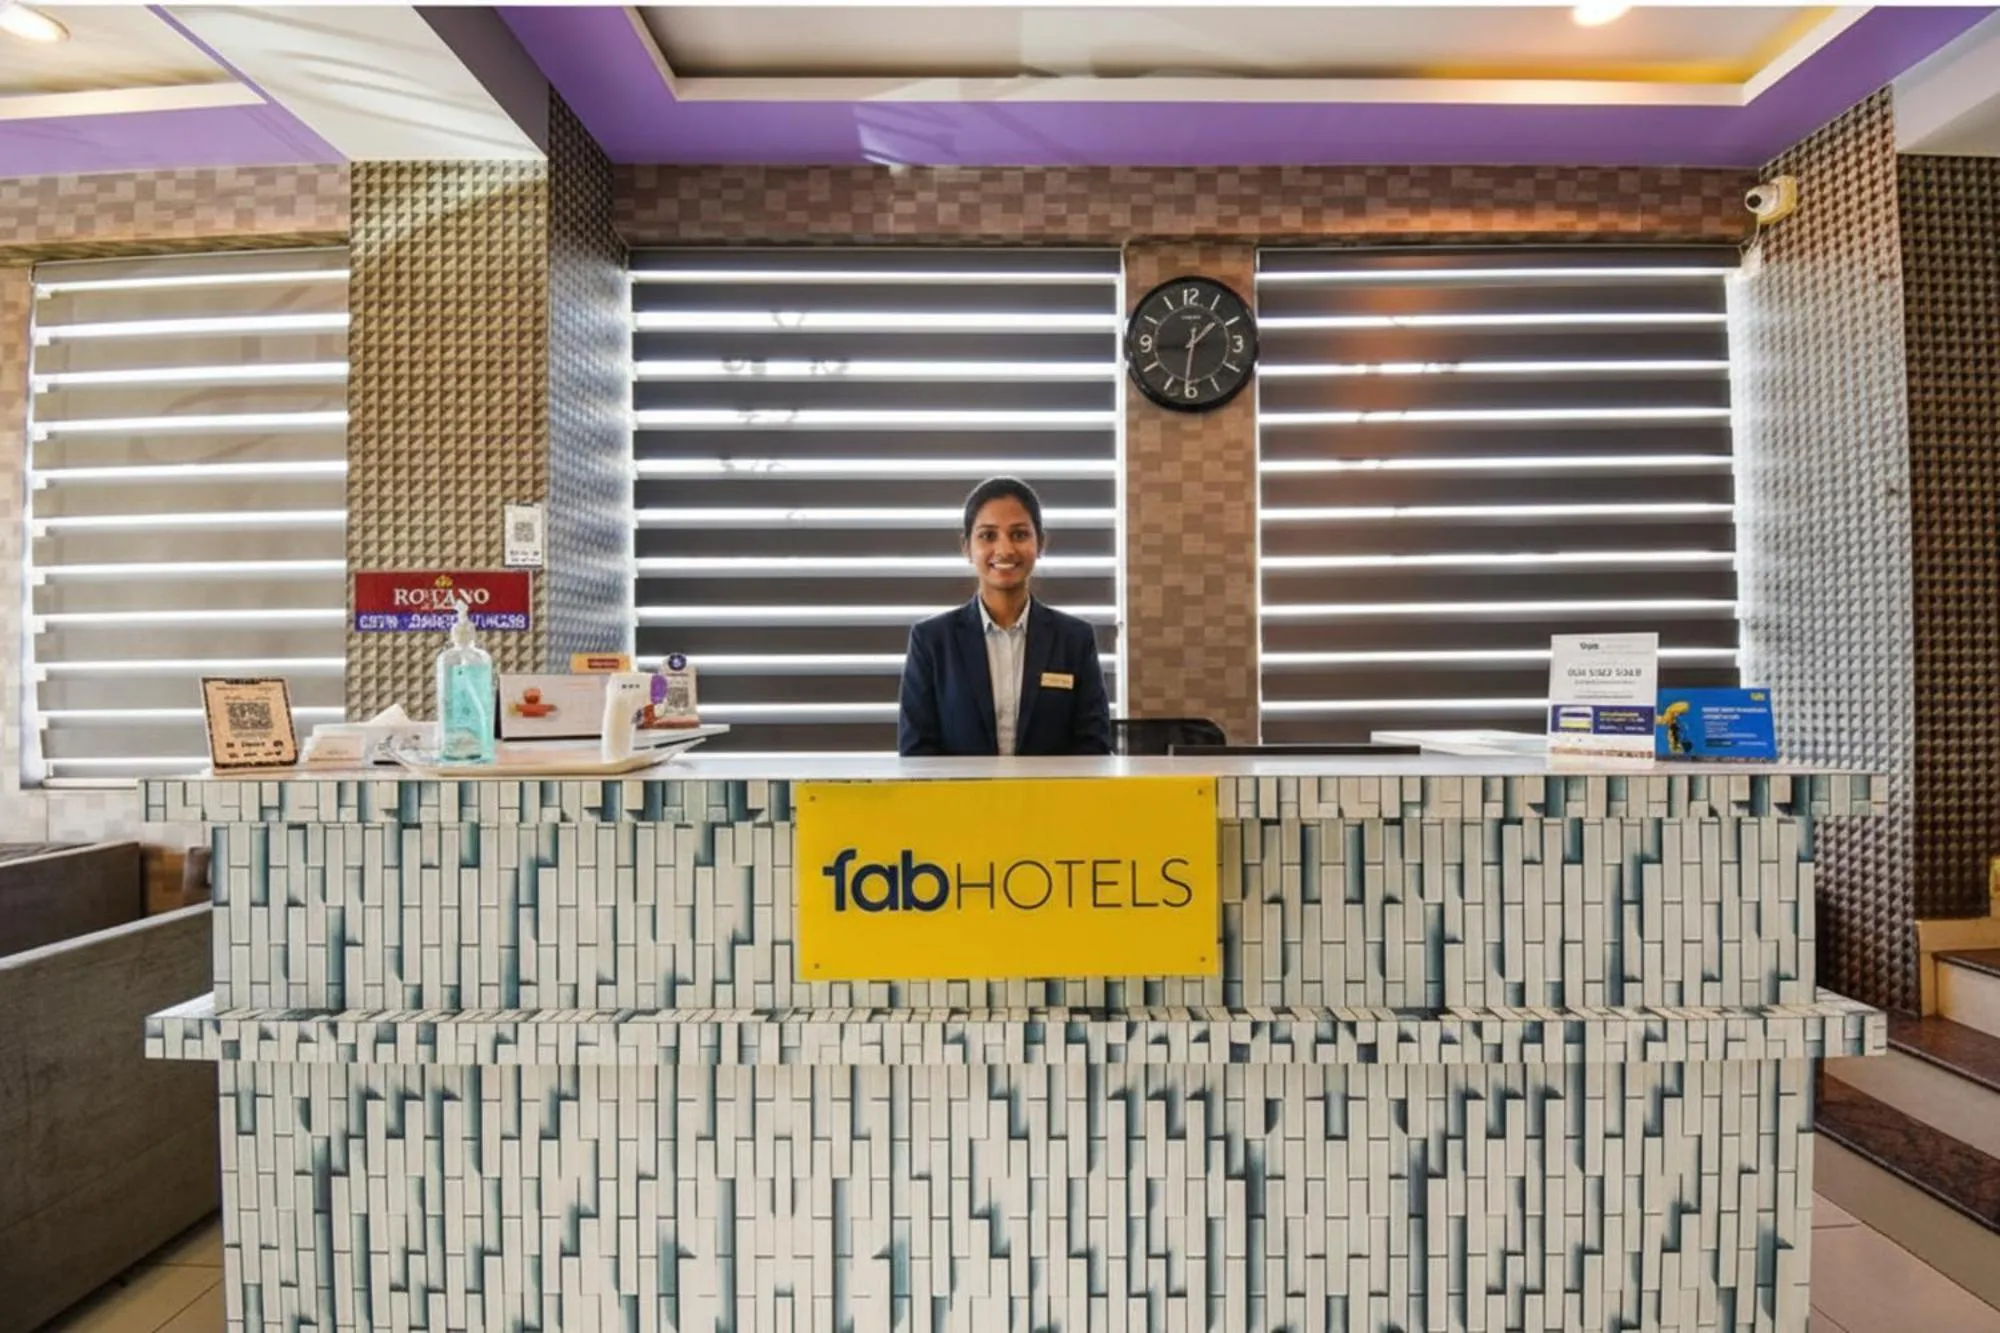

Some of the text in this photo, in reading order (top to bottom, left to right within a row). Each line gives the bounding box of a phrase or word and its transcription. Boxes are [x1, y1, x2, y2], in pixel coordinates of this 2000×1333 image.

[1183, 287, 1200, 306] 12
[1138, 334, 1153, 353] 9
[1231, 335, 1245, 354] 3
[1184, 380, 1199, 399] 6
[822, 848, 1194, 913] fabHOTELS
